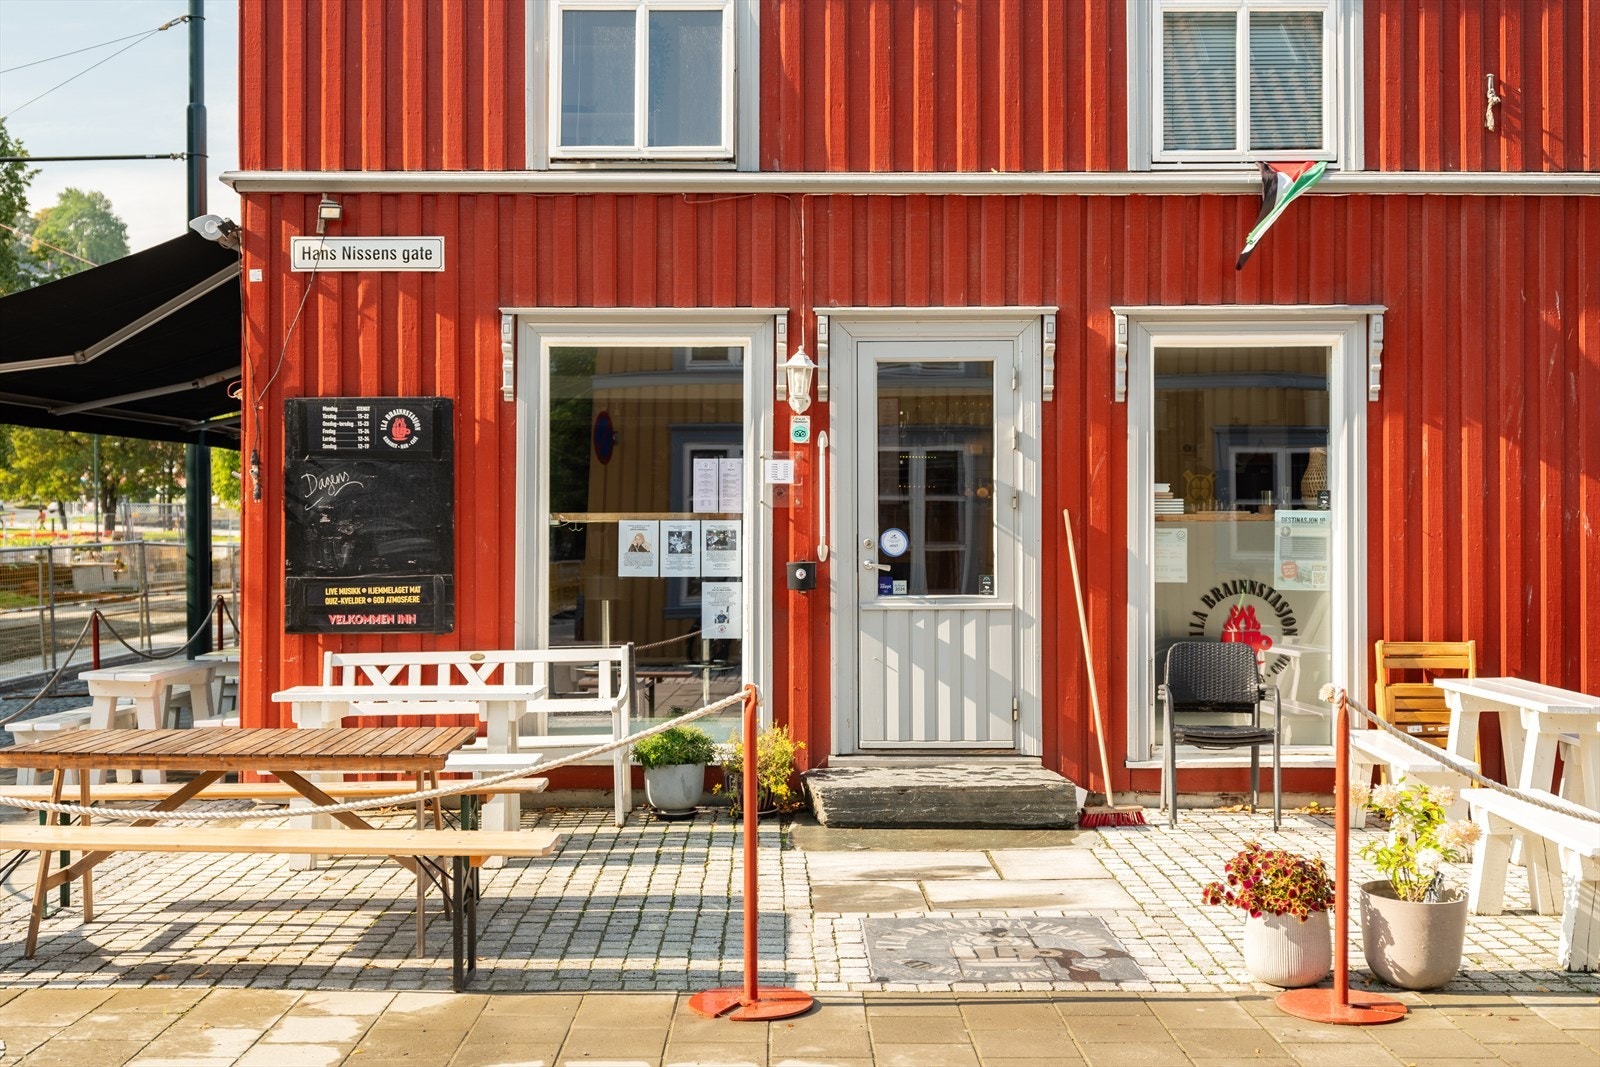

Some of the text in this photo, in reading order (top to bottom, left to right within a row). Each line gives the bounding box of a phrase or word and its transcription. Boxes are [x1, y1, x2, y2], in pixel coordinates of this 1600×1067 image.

[302, 246, 433, 263] Hans Nissens gate
[301, 471, 350, 498] Dagens
[325, 585, 421, 596] LIVE MUSIKK HJEMMELAGET MAT
[324, 595, 420, 606] QUIZ-KVELDER GOD ATMOSFÆRE
[1189, 579, 1298, 637] ILA BRAINNSTASJON
[328, 613, 417, 625] VELKOMMEN INN
